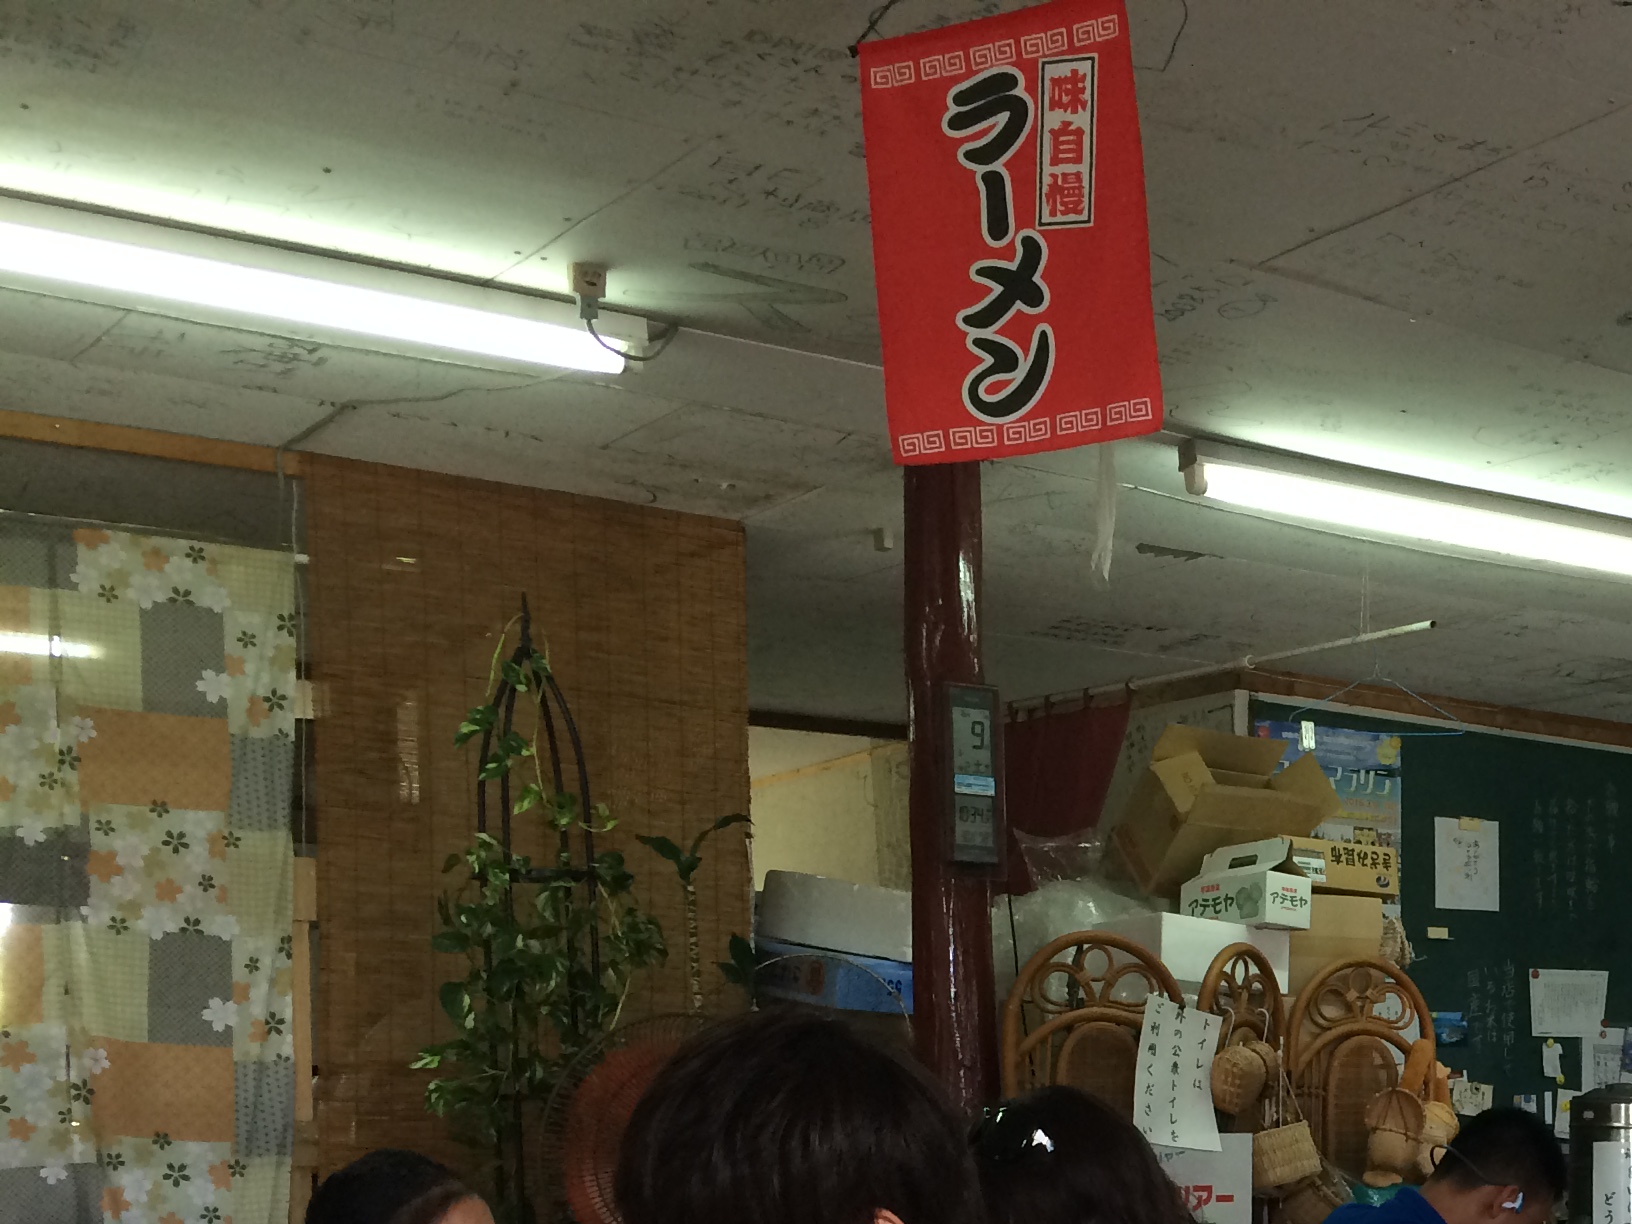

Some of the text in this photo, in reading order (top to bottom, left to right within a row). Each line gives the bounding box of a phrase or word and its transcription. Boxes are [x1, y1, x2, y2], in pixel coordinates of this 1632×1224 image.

[1045, 68, 1088, 219] 味自慢
[943, 68, 1053, 421] ラーメン
[970, 720, 985, 750] 9
[1330, 845, 1392, 872] きざみ昆布
[1187, 893, 1236, 917] アテモヤ
[1269, 891, 1308, 909] アテモヤ
[1142, 1002, 1165, 1135] ご利用ください
[1169, 1008, 1187, 1143] 外の公衆トイレを
[1192, 1017, 1211, 1091] トイレは
